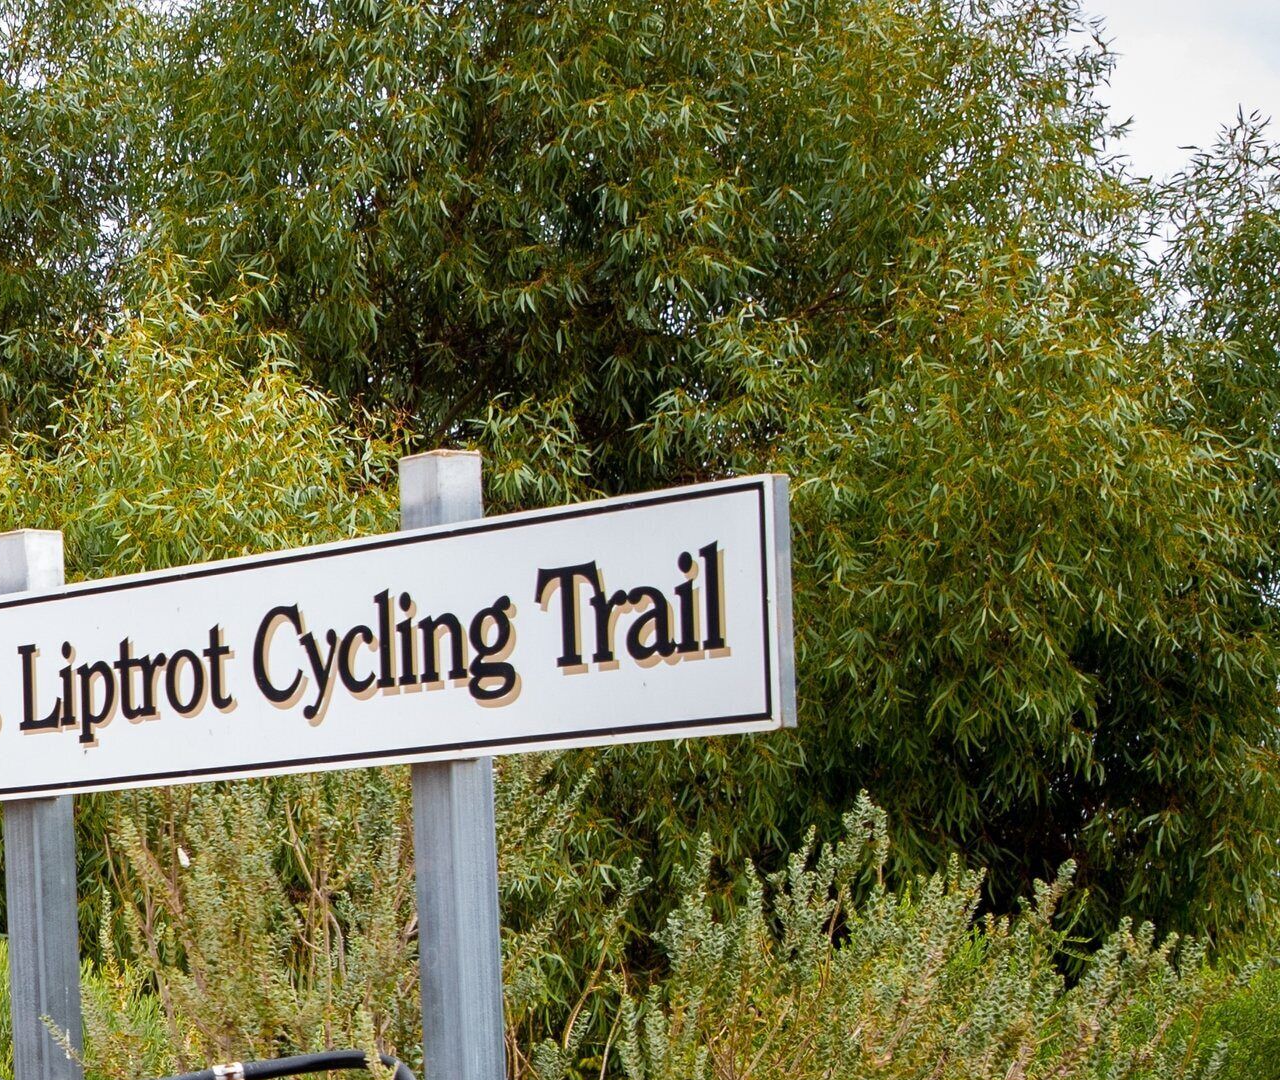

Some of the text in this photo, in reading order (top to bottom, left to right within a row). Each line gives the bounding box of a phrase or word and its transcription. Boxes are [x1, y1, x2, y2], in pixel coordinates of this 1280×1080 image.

[18, 623, 235, 745] Liptrot
[253, 587, 520, 722] Cycling
[535, 540, 728, 668] Trail
